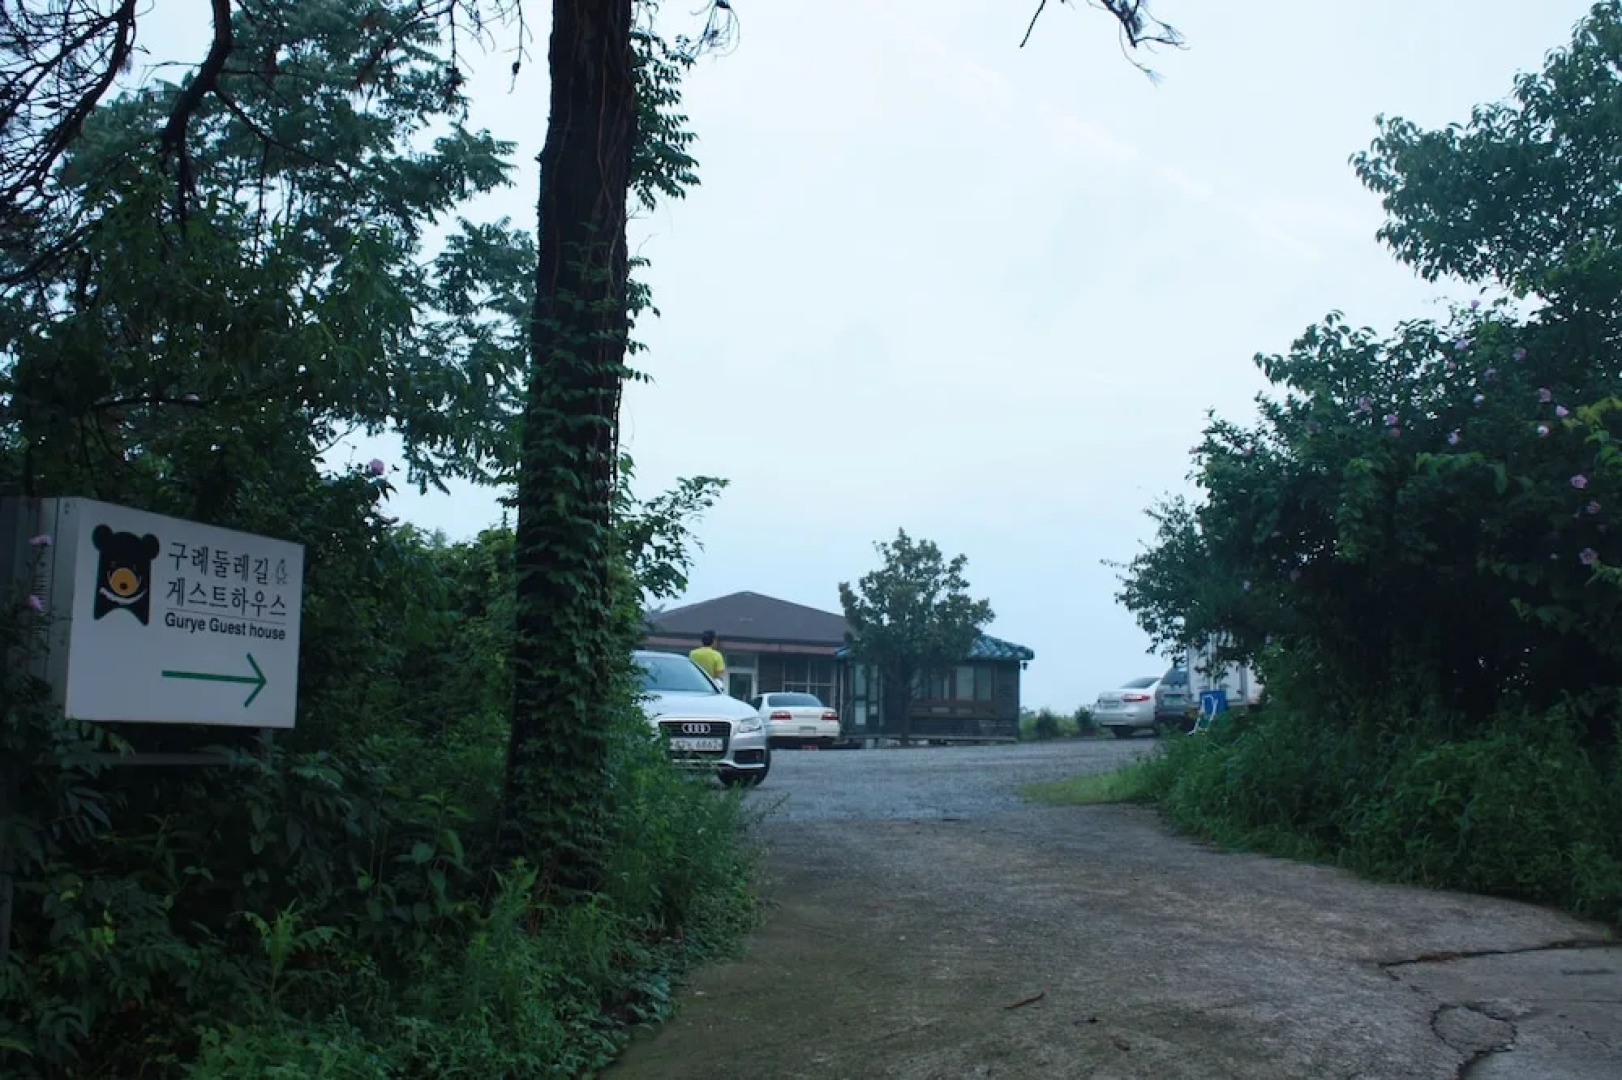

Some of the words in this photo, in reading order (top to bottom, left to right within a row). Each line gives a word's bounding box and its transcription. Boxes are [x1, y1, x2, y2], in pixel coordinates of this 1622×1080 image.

[168, 542, 269, 585] 구례둘레길
[166, 577, 287, 618] 게스트하우스
[165, 612, 206, 634] Gurye
[209, 618, 246, 636] Guest
[249, 622, 286, 641] house
